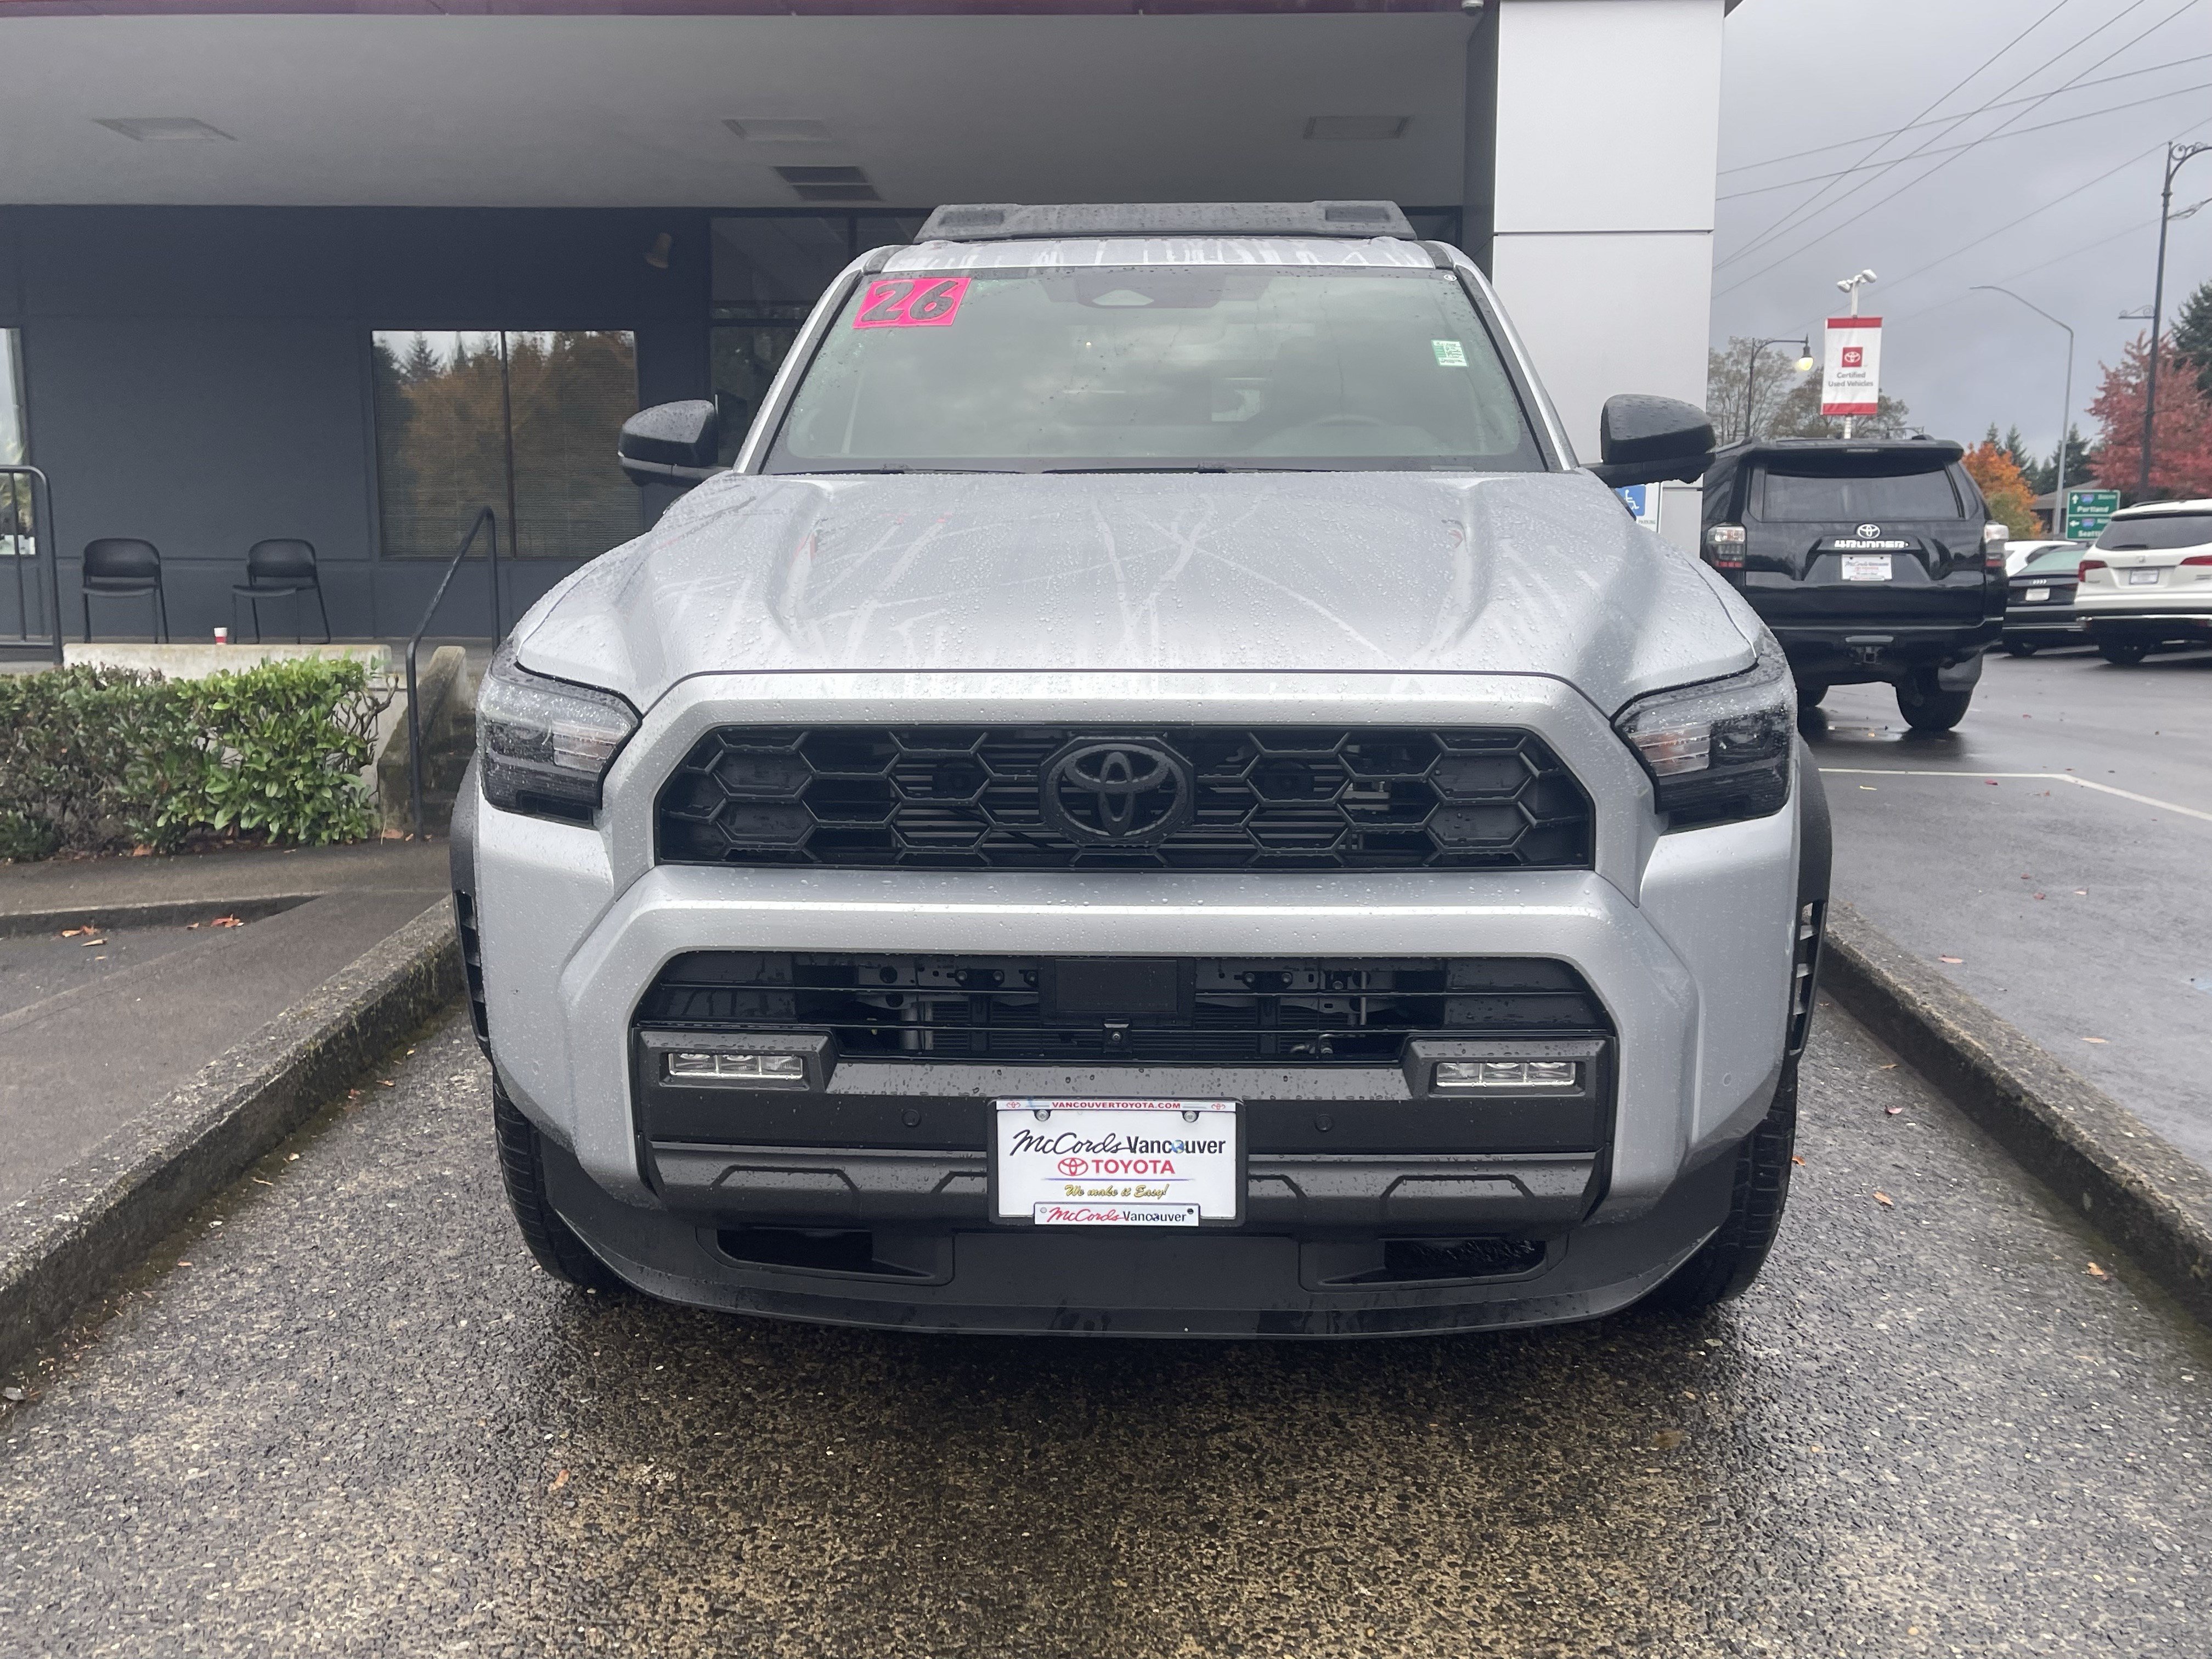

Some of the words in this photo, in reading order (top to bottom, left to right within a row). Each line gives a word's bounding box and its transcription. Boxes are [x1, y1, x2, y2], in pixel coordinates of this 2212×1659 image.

[861, 280, 958, 322] 26
[1834, 540, 1905, 548] 4RUNNER
[1052, 1101, 1181, 1109] VANCOUVERTOYOTA.COM
[1091, 1159, 1176, 1174] TOYOTA
[1064, 1184, 1085, 1197] We
[1087, 1185, 1119, 1197] make
[1120, 1187, 1132, 1197] it
[1133, 1183, 1170, 1200] Easy!
